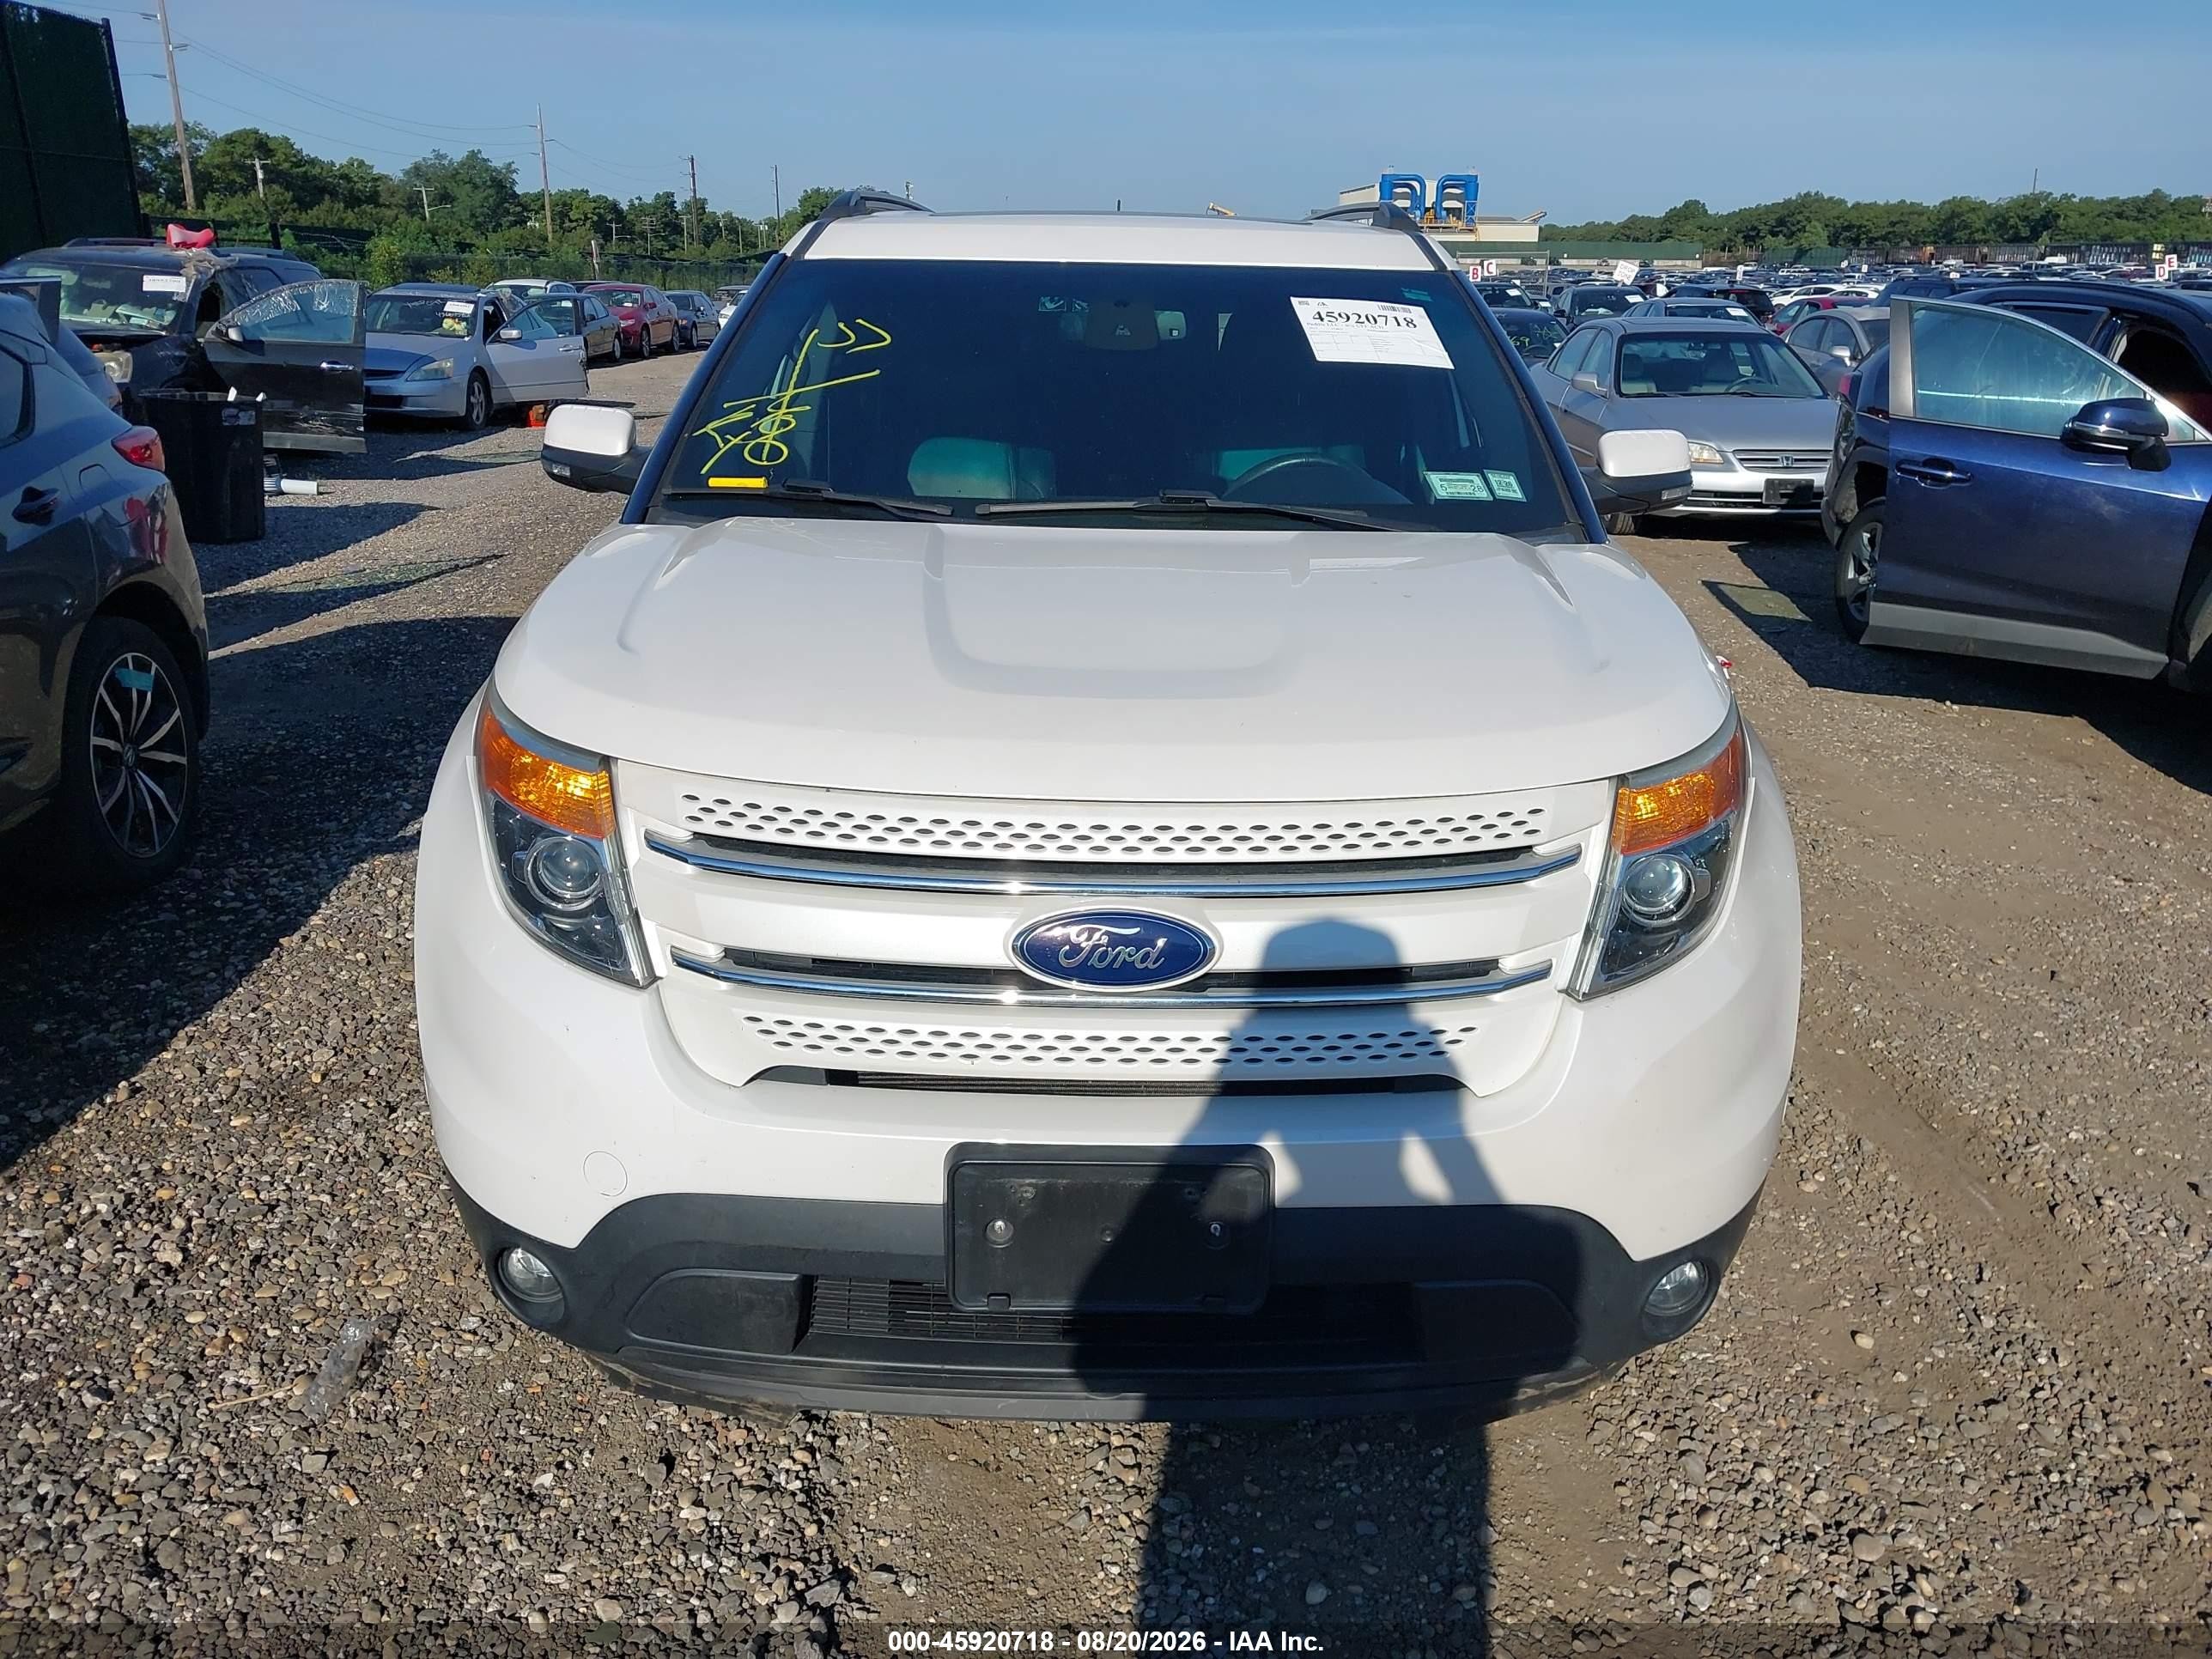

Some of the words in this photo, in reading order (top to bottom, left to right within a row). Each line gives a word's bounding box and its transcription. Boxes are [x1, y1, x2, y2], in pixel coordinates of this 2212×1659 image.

[1486, 262, 1494, 275] C
[2168, 258, 2175, 268] E
[1472, 267, 1479, 280] B
[2159, 266, 2166, 277] D
[1312, 310, 1418, 329] 45920718
[1058, 924, 1169, 969] Ford
